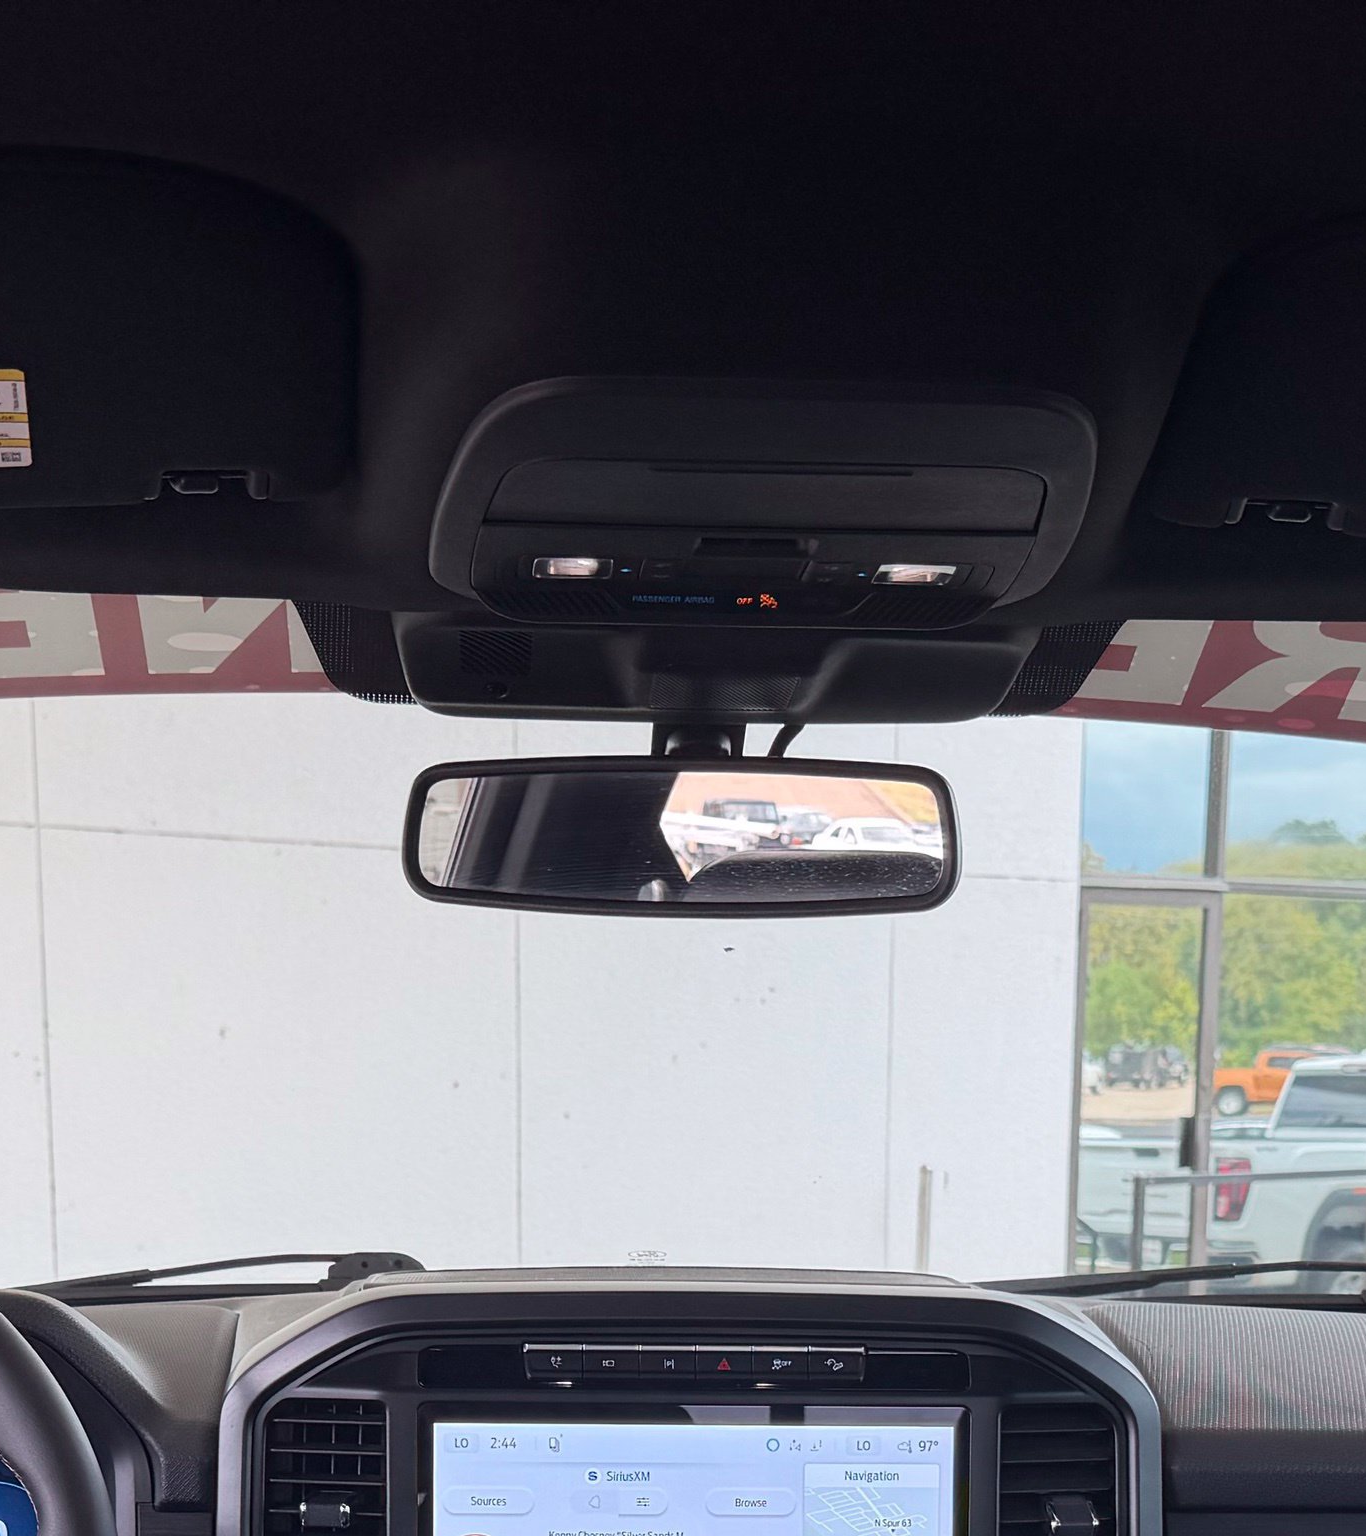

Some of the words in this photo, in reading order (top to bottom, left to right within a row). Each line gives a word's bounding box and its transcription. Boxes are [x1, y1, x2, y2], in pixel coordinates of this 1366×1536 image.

[736, 597, 754, 605] OFF
[454, 1437, 469, 1448] LO
[490, 1437, 517, 1449] 2:44
[856, 1440, 871, 1451] LO
[606, 1471, 651, 1482] SiriusXM
[844, 1470, 900, 1482] Navigation
[470, 1496, 507, 1507] Sources
[735, 1498, 768, 1507] Browse
[875, 1519, 881, 1528] N
[882, 1519, 901, 1529] Spur
[901, 1519, 912, 1528] 63
